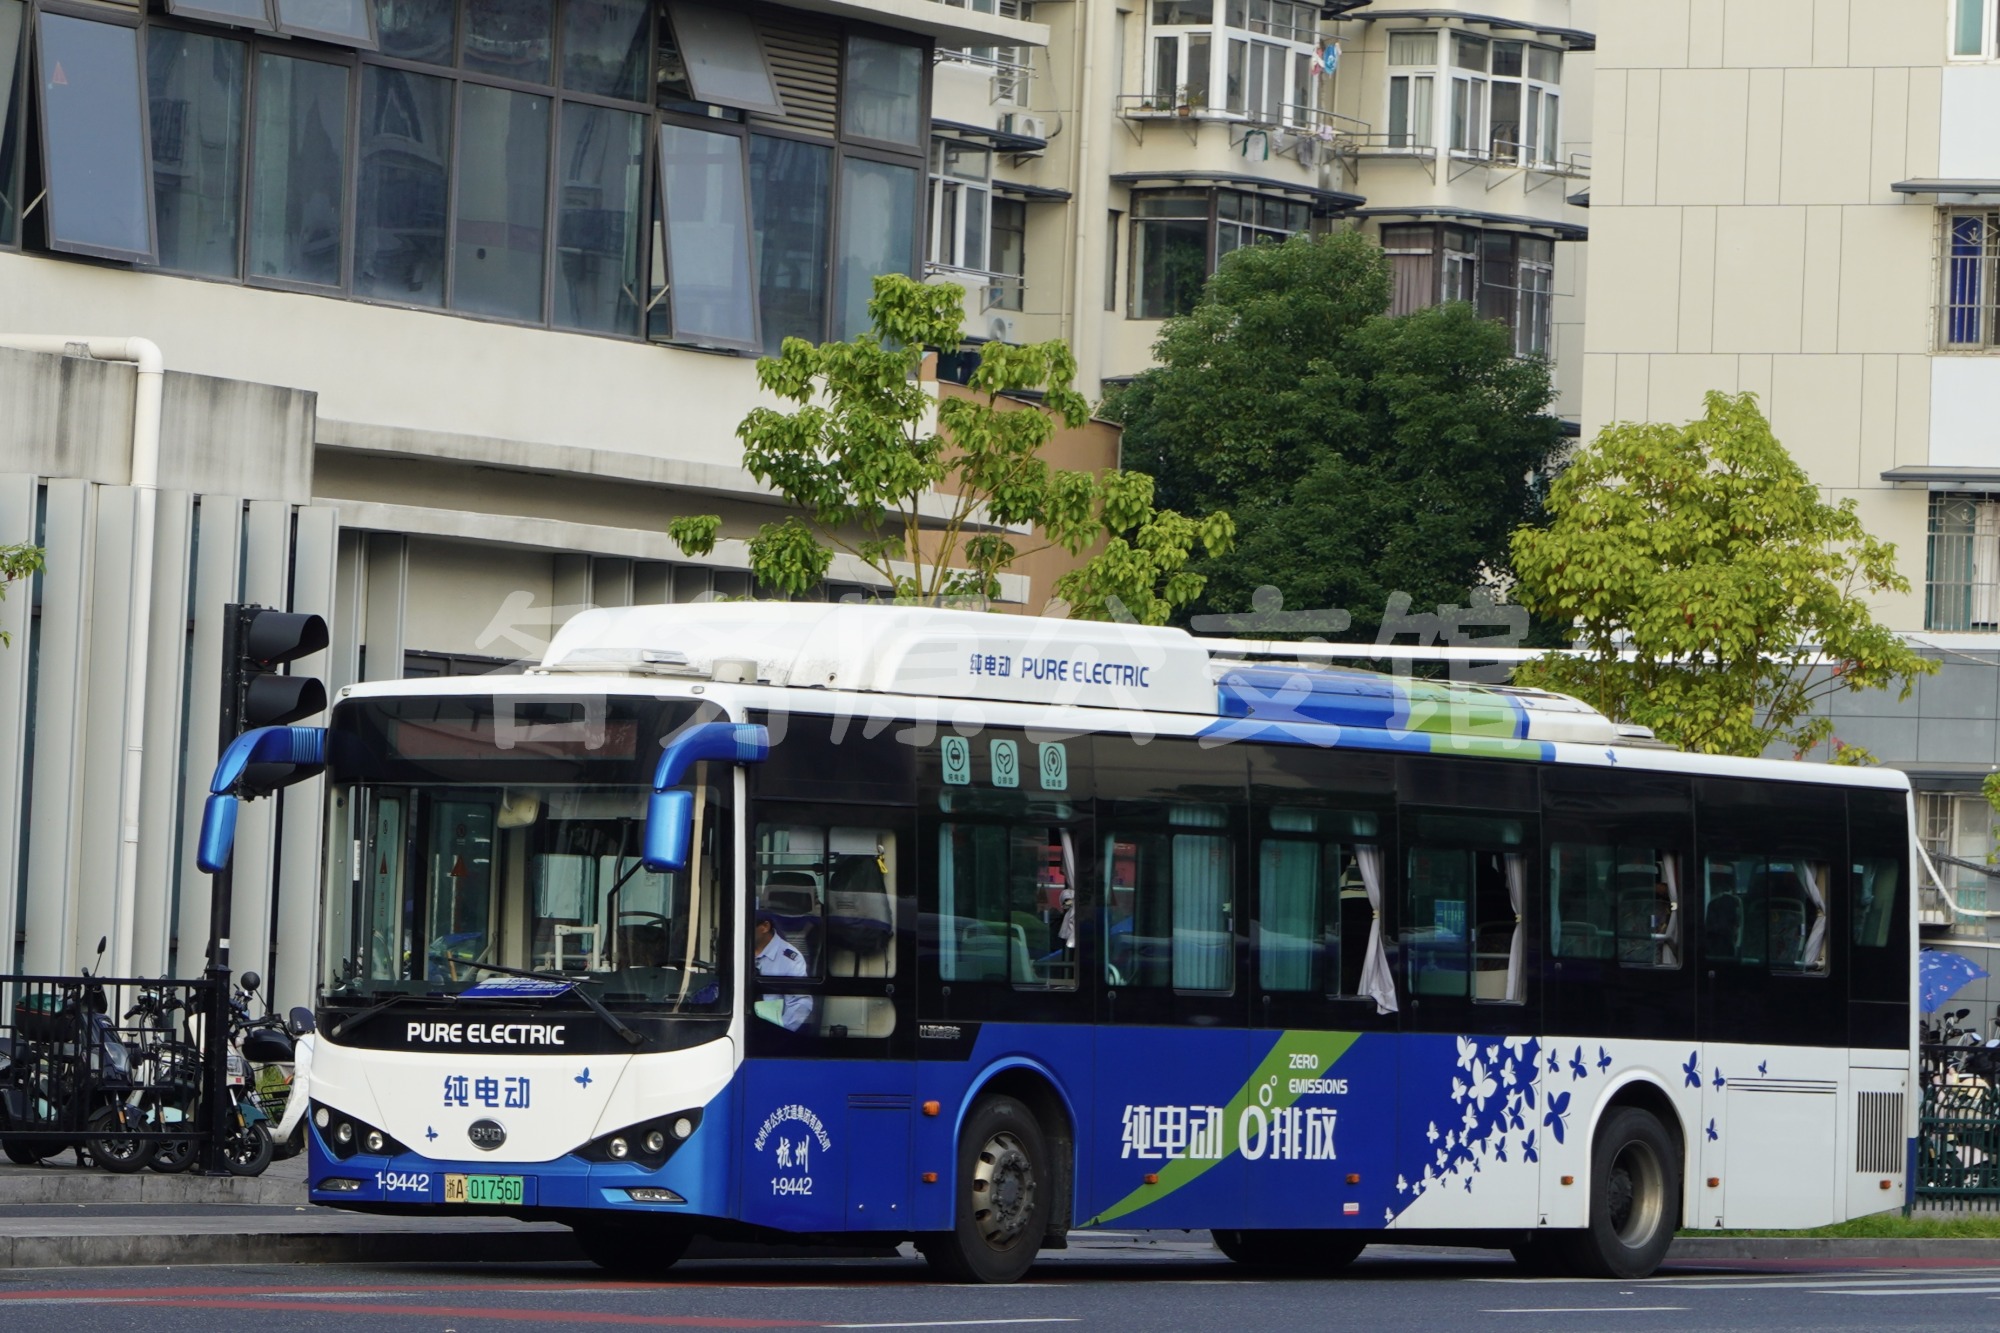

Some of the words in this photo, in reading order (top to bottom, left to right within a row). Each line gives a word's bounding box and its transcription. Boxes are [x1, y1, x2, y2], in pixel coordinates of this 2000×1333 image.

[969, 653, 1011, 678] 纯电动
[1021, 655, 1068, 682] PURE
[1073, 661, 1150, 689] ELECTRIC
[406, 1022, 463, 1043] PURE
[467, 1022, 566, 1046] ELECTRIC
[1288, 1053, 1319, 1070] ZERO
[443, 1075, 531, 1109] 纯电动
[1288, 1077, 1348, 1096] EMISSIONS
[471, 1126, 502, 1141] BYD
[753, 1104, 832, 1153] 杭州市公共交通集团有限公司
[1121, 1104, 1224, 1160] 纯电动
[1238, 1104, 1337, 1161] 0排放
[775, 1134, 810, 1174] 杭州
[374, 1171, 430, 1193] 1-9442
[470, 1179, 522, 1201] 01756D
[770, 1176, 813, 1196] 1-9442
